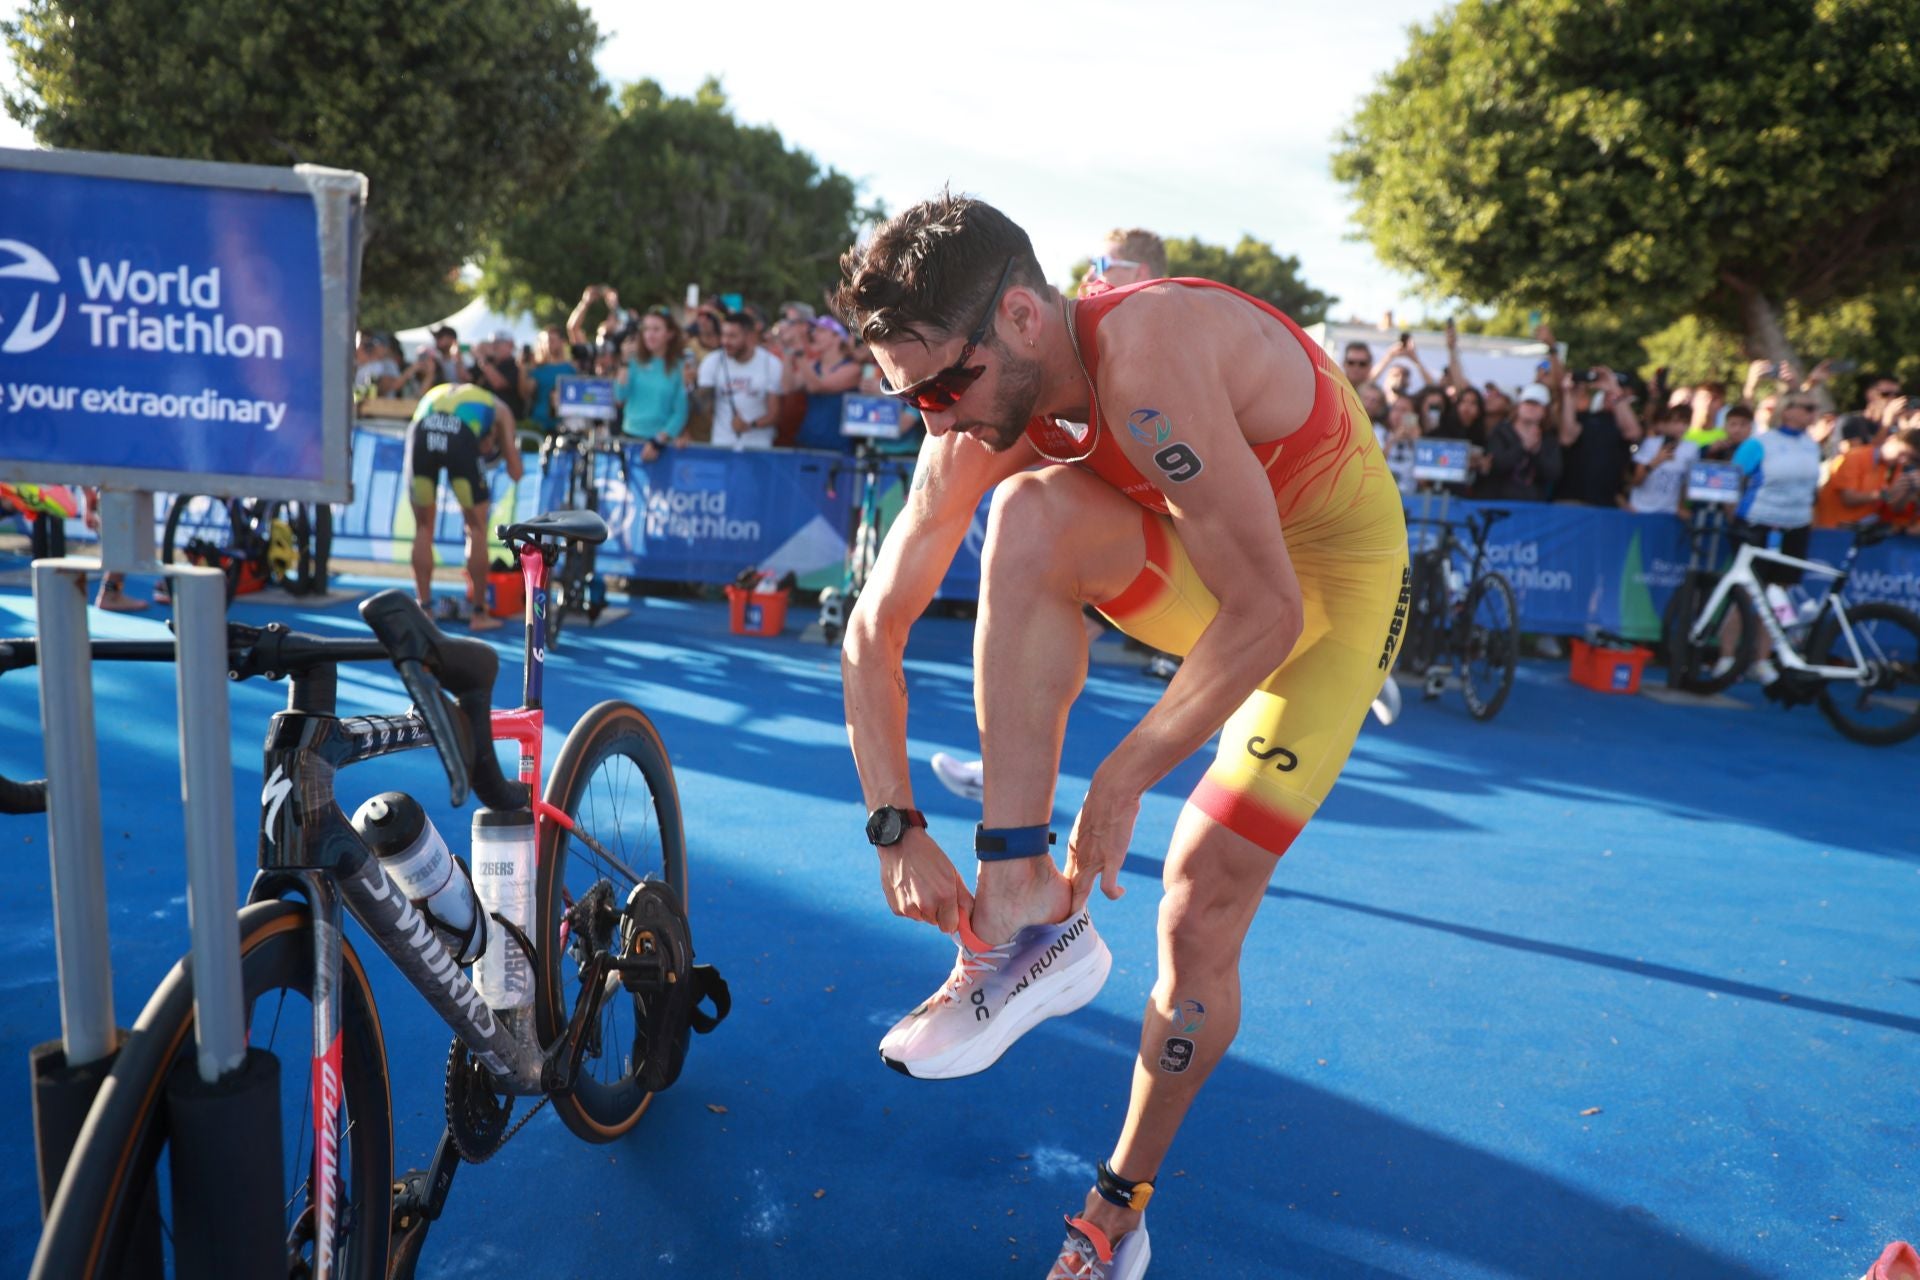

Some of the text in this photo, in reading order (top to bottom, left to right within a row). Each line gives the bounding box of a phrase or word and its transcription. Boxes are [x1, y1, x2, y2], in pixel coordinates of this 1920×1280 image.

[78, 256, 220, 309] World
[79, 303, 284, 359] Triathlon
[8, 383, 79, 412] your
[81, 386, 287, 431] extraordinary
[1153, 441, 1203, 483] 9
[403, 849, 442, 886] 226ERS
[1029, 911, 1090, 980] RUNNIN
[1160, 1037, 1195, 1074] 9
[316, 1061, 338, 1271] SPECIALIZED
